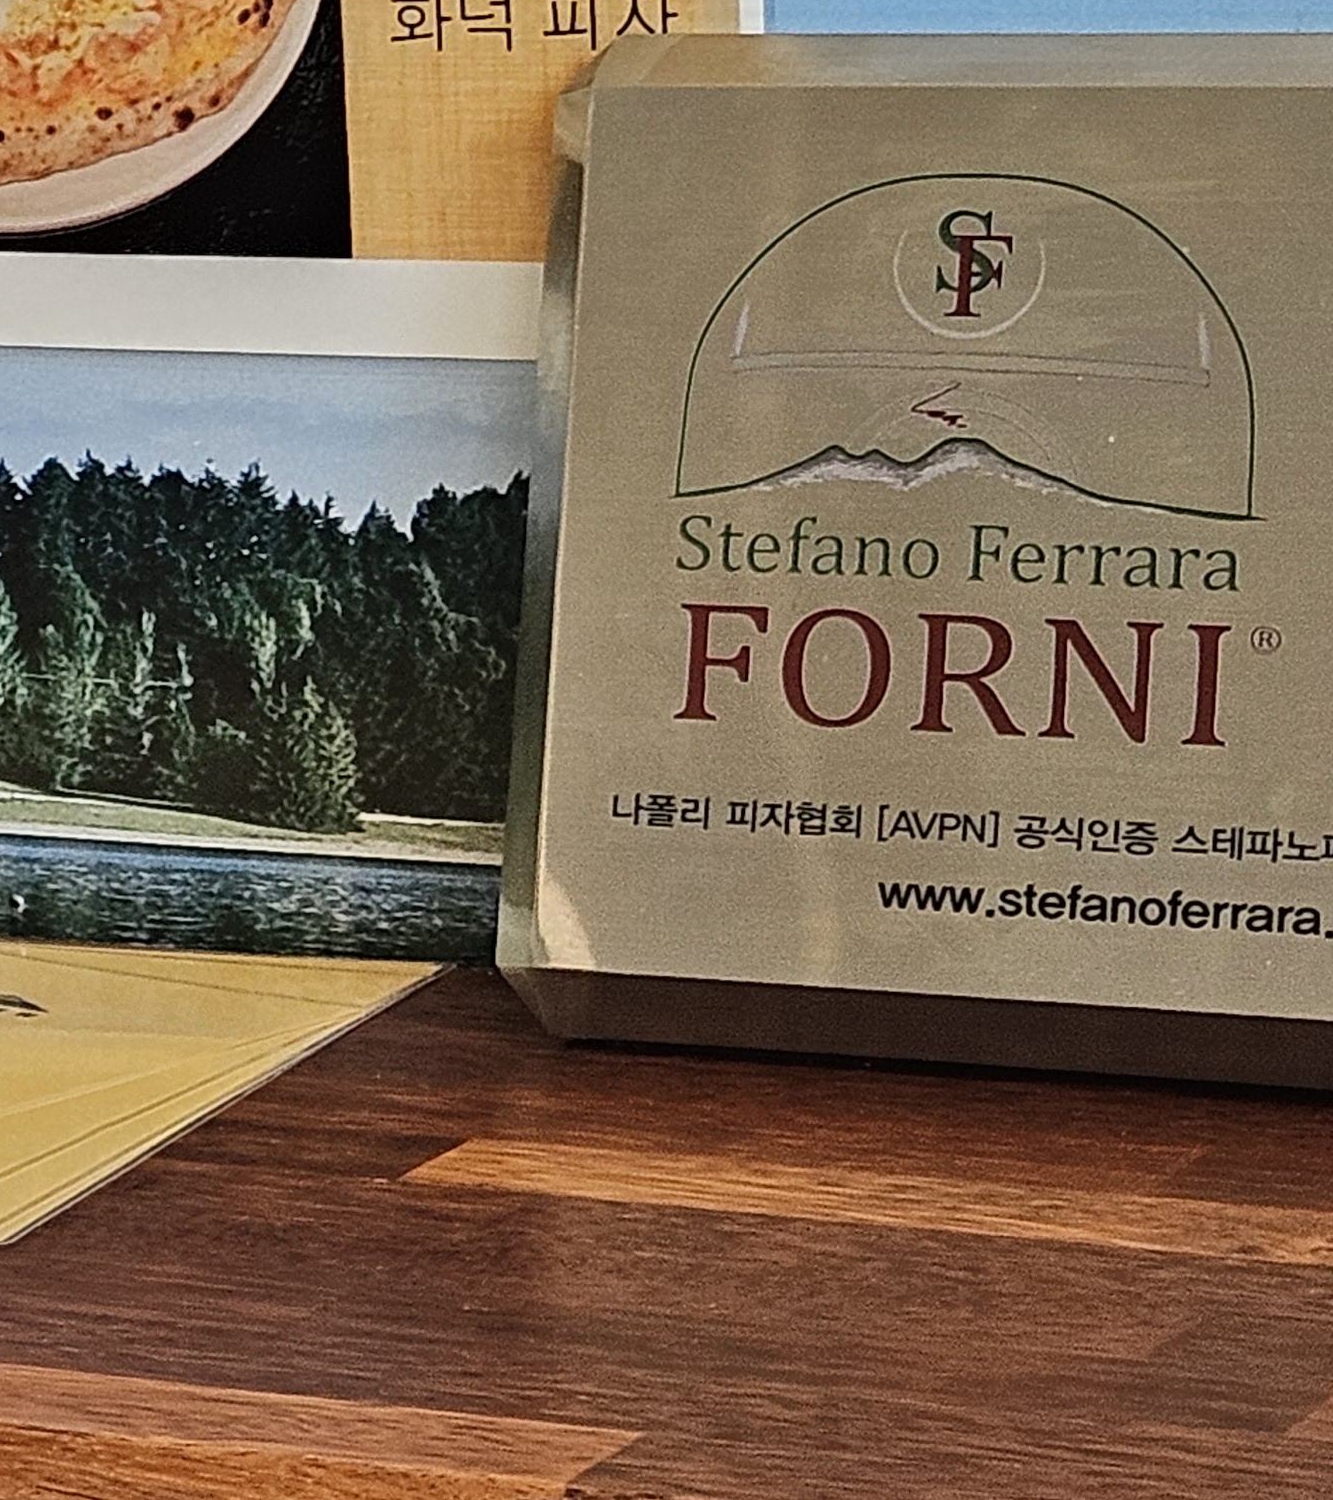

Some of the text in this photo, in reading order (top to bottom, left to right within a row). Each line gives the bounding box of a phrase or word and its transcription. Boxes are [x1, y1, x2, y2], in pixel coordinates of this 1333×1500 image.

[675, 513, 1240, 592] Stefano Ferrara
[611, 793, 711, 830] 나폴리
[725, 799, 863, 839] 피자협회
[876, 804, 1001, 848] [AVPN]
[1013, 814, 1160, 856] 공식인증
